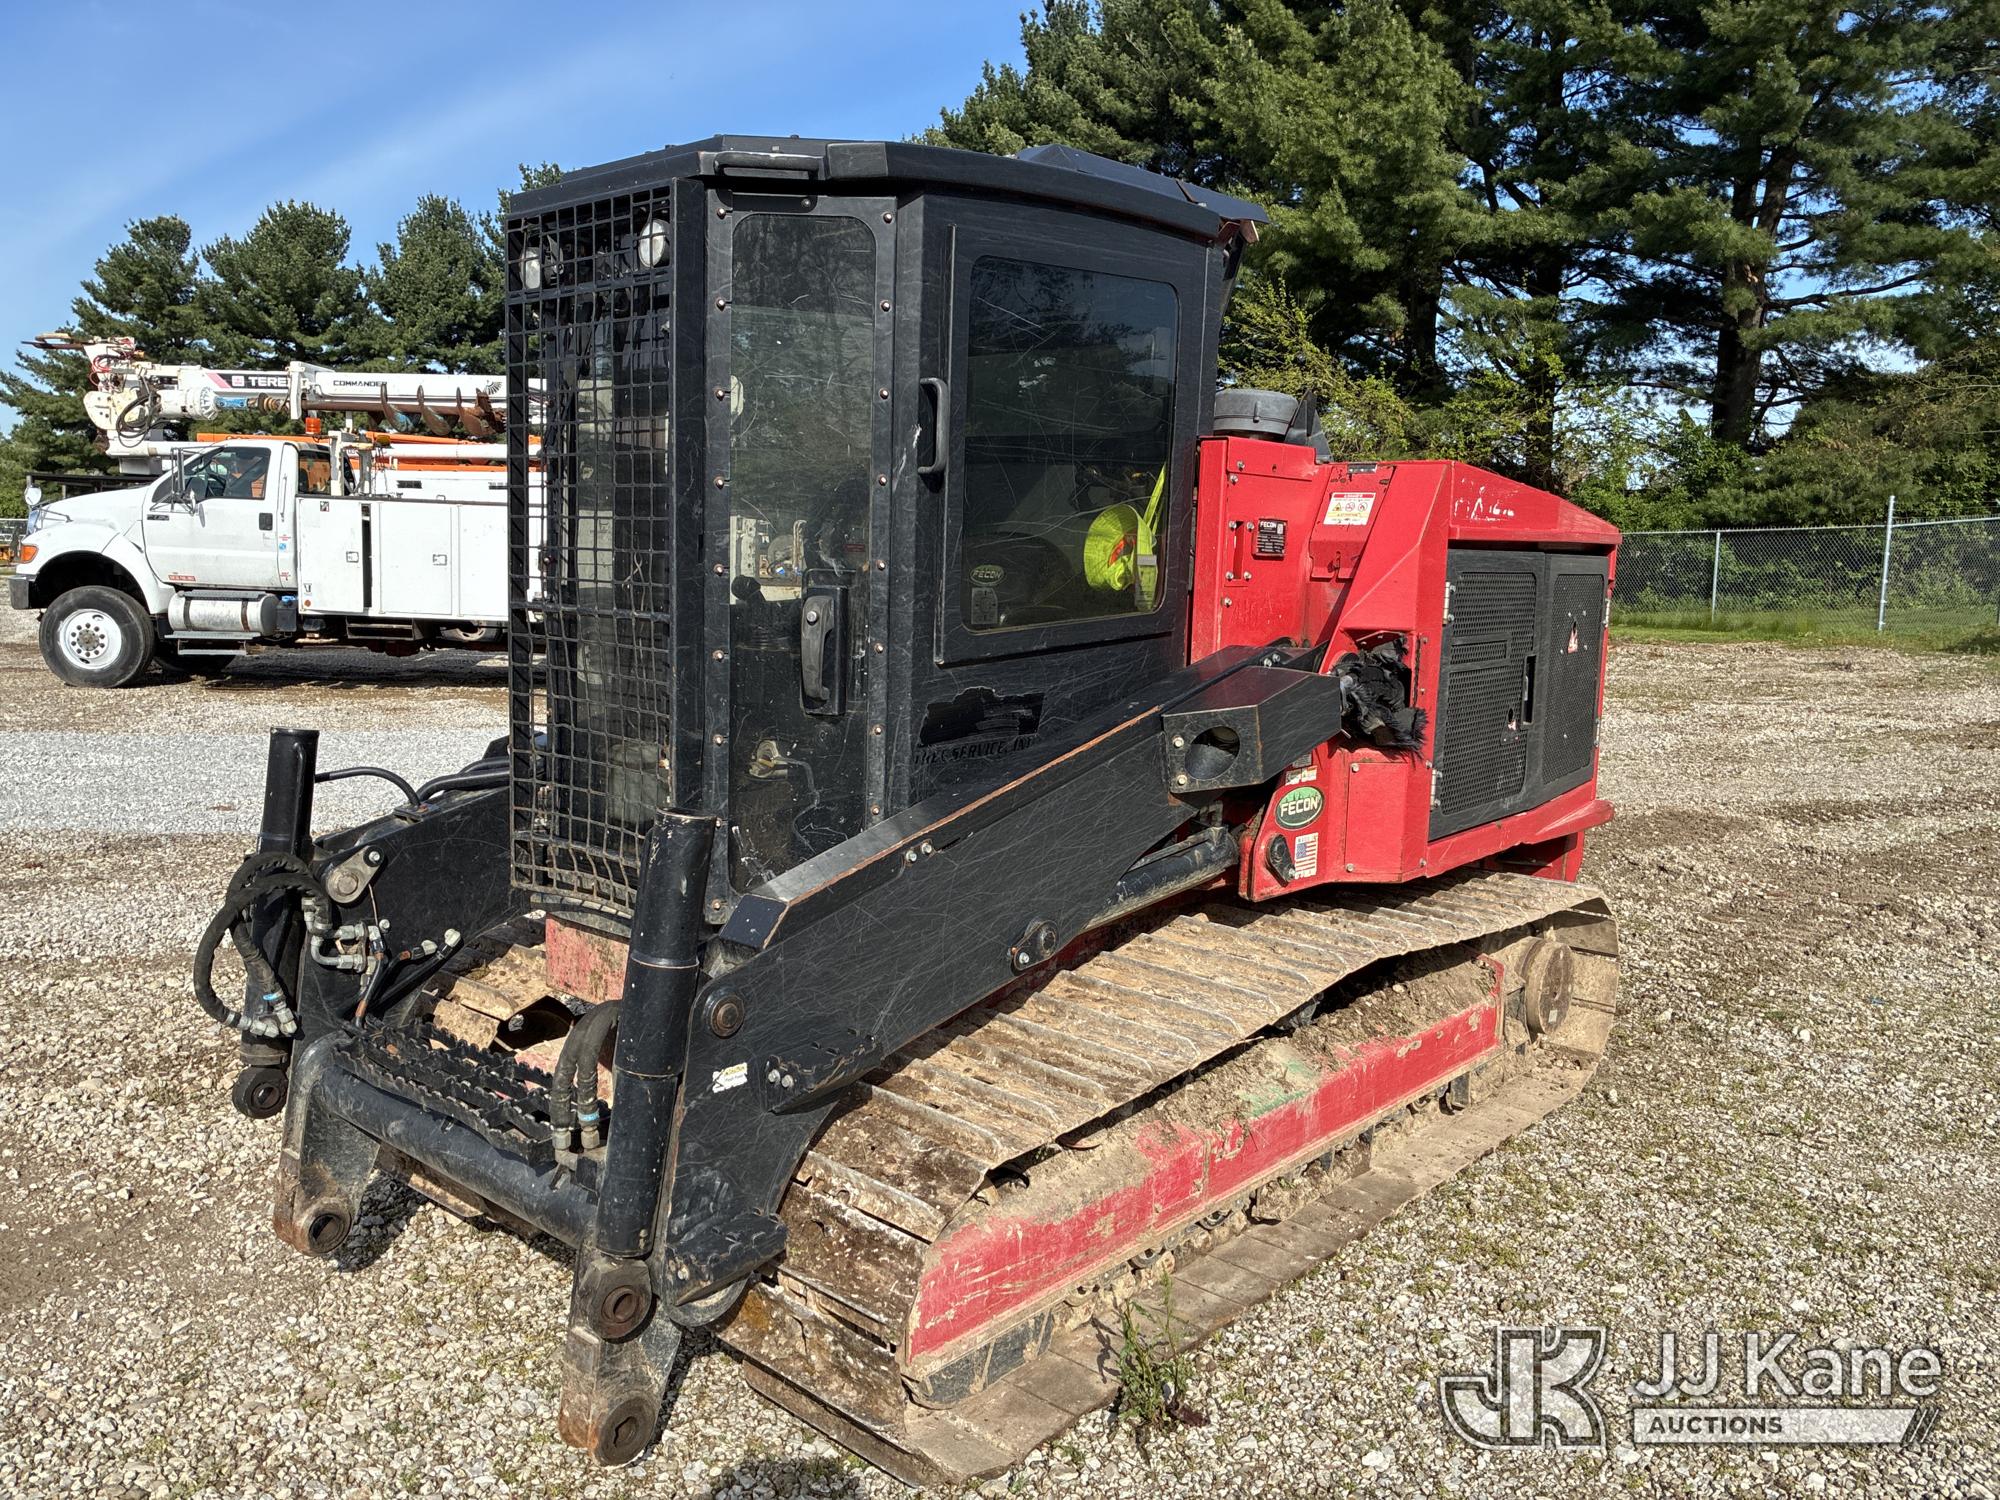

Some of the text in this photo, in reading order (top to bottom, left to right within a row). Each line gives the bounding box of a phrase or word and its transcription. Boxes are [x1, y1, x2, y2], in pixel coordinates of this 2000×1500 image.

[248, 376, 290, 388] TERE
[972, 570, 1002, 579] FECON
[1280, 795, 1319, 817] FECON
